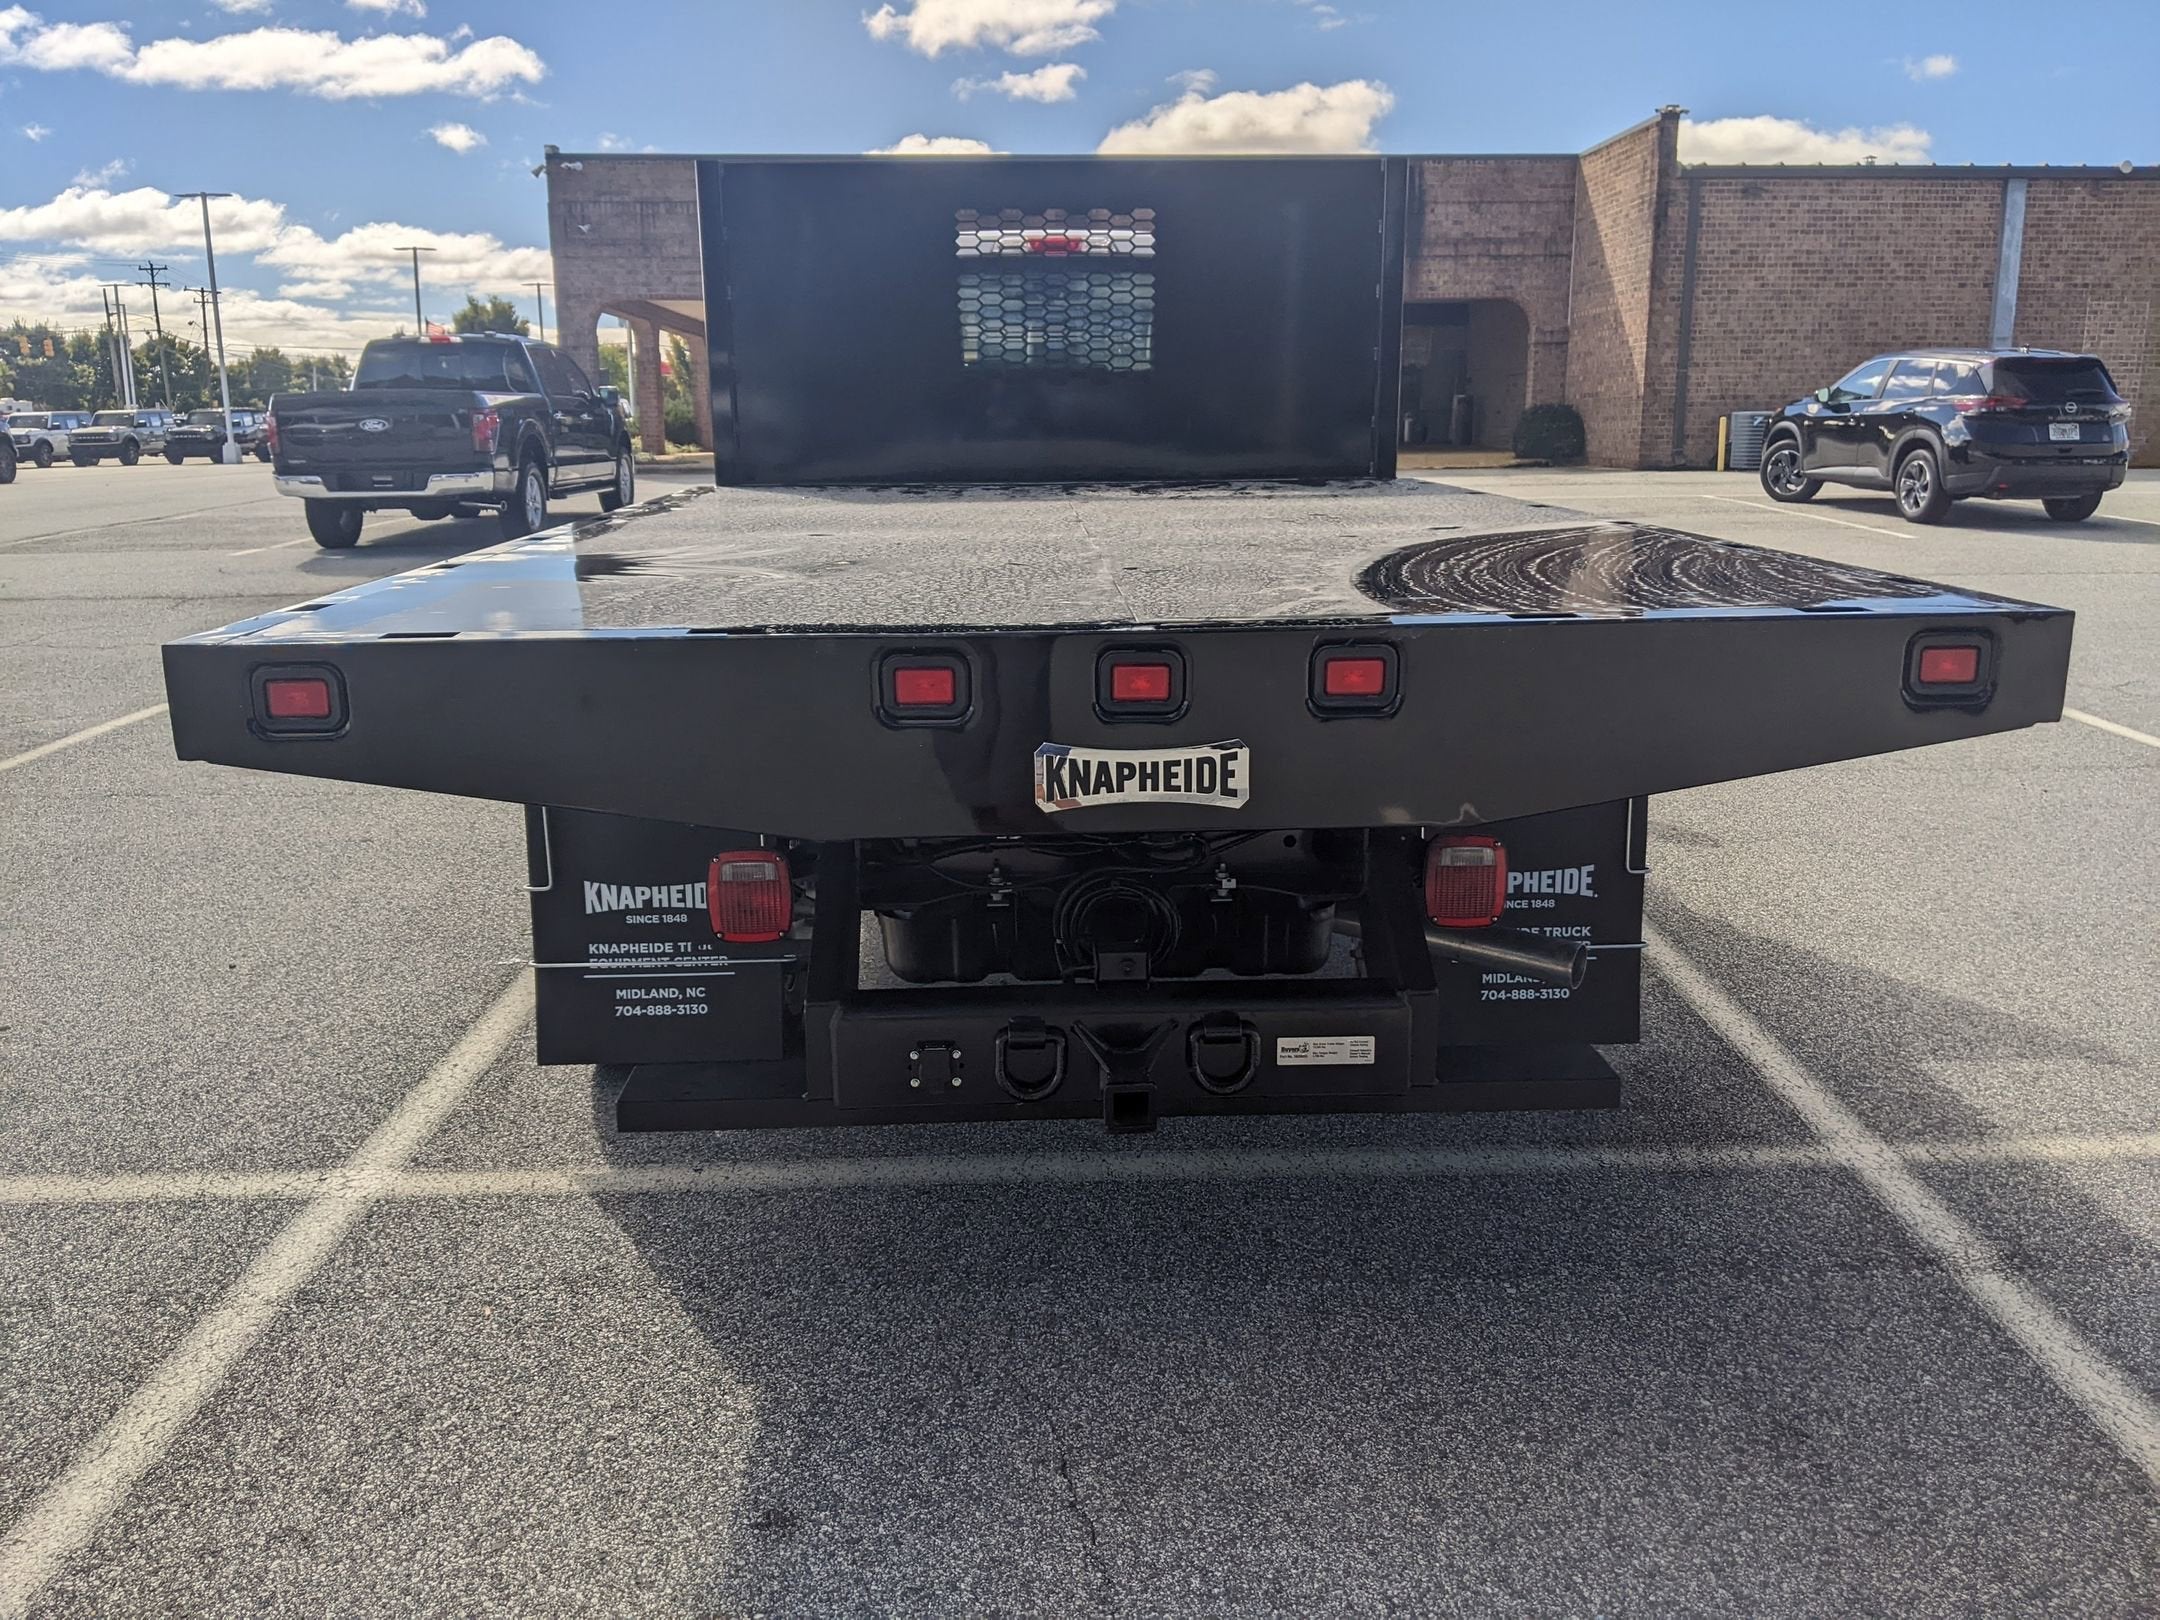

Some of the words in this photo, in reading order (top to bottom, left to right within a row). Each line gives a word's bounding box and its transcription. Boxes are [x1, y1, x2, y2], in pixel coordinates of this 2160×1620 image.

[1044, 751, 1239, 801] KNAPHEIDE
[1507, 864, 1595, 897] PHEIDE
[583, 880, 708, 914] KNAPHEID
[1504, 900, 1529, 909] NCE
[1531, 899, 1556, 908] 1848
[625, 914, 660, 924] SINCE
[662, 913, 688, 923] 1848
[1544, 926, 1592, 938] TRUCK
[588, 942, 674, 954] KNAPHEIDE
[615, 988, 683, 1000] MIDLAND,
[686, 987, 707, 998] NC
[1480, 988, 1570, 1001] 704-888-3130
[614, 1003, 708, 1017] 704-888-3130
